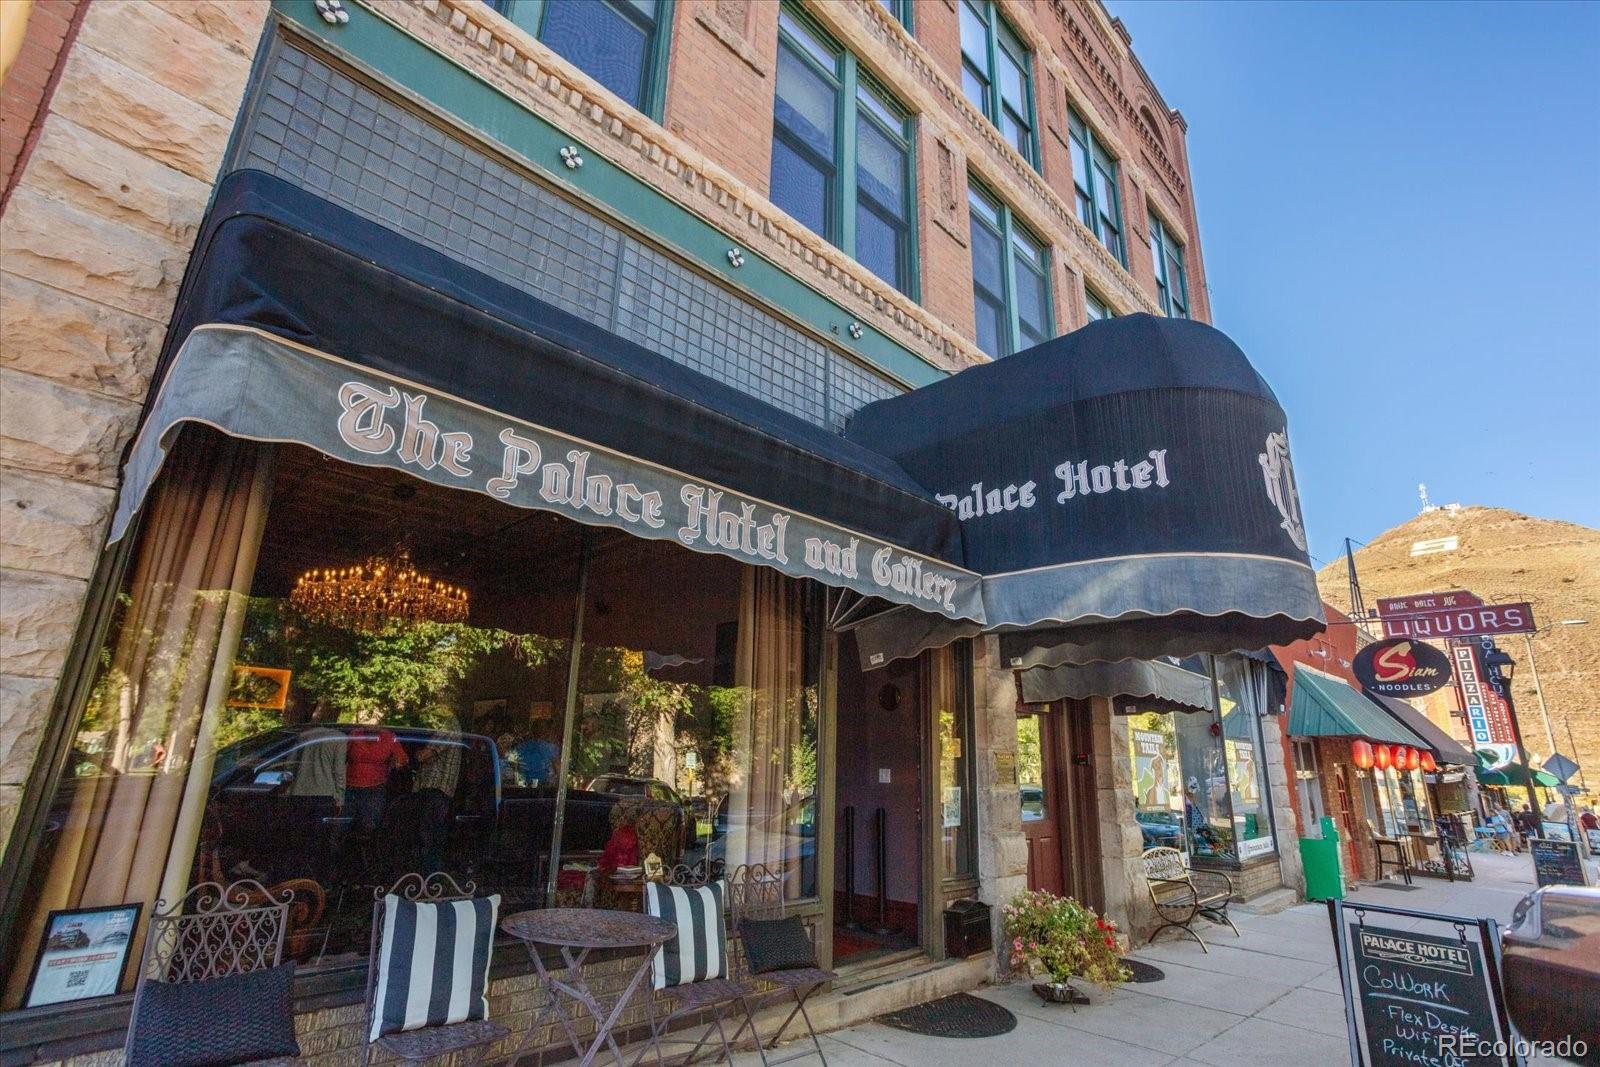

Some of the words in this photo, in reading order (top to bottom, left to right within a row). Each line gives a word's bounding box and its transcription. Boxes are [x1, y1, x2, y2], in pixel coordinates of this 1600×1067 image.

[1054, 449, 1170, 504] Hotel
[338, 380, 473, 478] The
[486, 427, 666, 528] Palace
[678, 484, 791, 565] Hotel
[804, 535, 859, 580] and
[873, 545, 957, 613] Gallery
[1387, 609, 1523, 636] LIQUORS
[1375, 641, 1439, 682] Siam
[1363, 935, 1416, 954] PALACE
[1417, 943, 1468, 963] HOTEL
[1388, 1005, 1423, 1026] Flex
